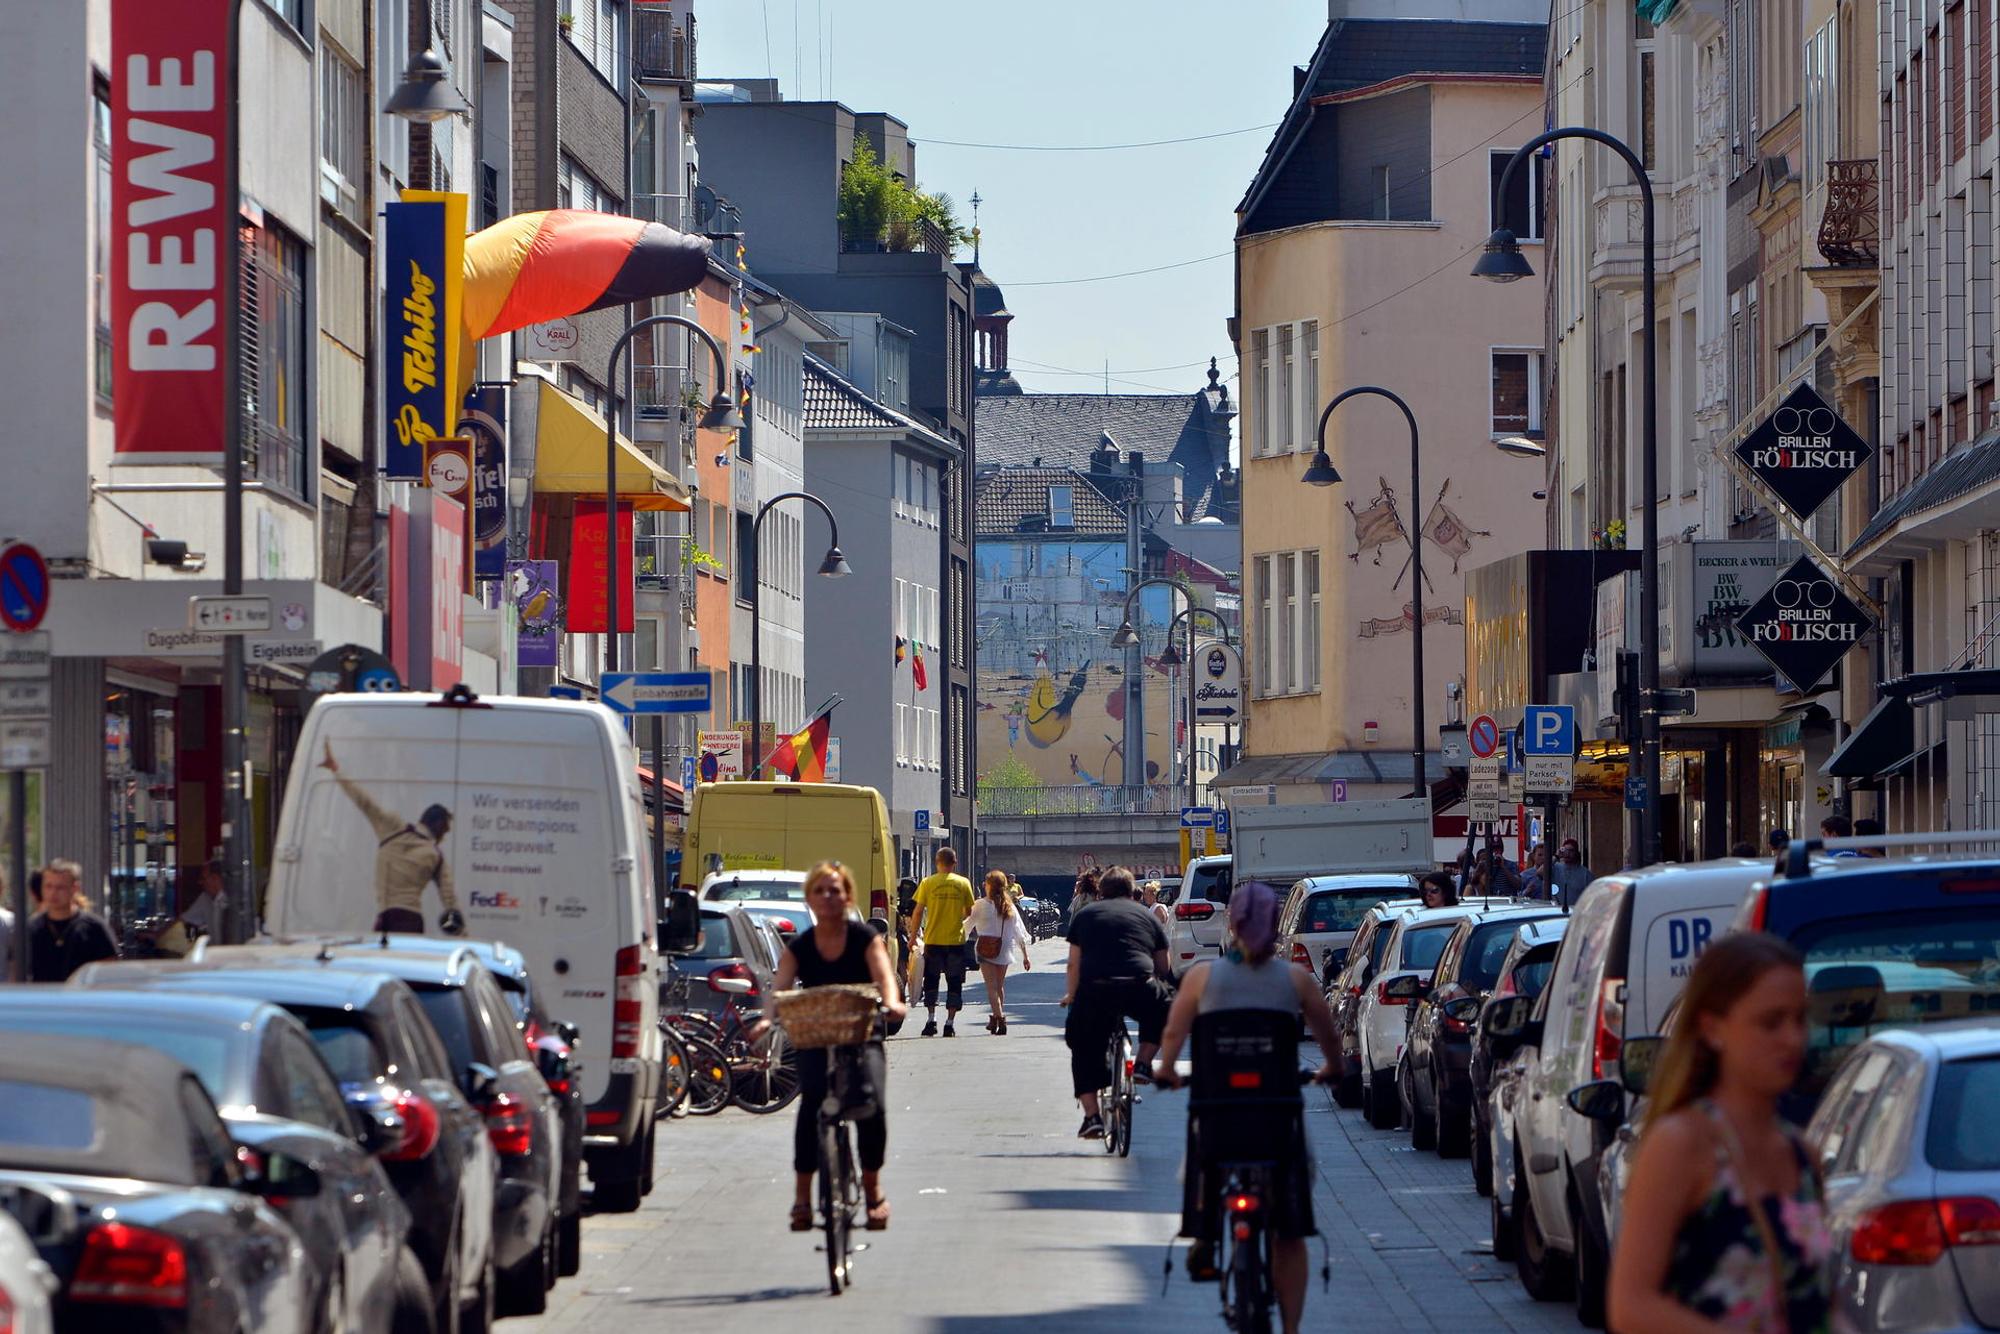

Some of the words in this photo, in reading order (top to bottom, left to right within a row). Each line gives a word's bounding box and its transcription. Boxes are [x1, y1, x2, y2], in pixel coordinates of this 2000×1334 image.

[127, 50, 215, 371] REWE
[403, 258, 436, 394] Tchibo
[546, 329, 570, 340] KRALL
[1778, 436, 1832, 449] BRILLEN
[1698, 557, 1739, 567] BECKER
[1740, 557, 1748, 567] &
[1717, 573, 1739, 585] BW
[1713, 584, 1743, 600] BW
[1778, 609, 1832, 621] BRILLEN
[252, 644, 318, 661] Eigelstein
[633, 687, 705, 698] Einbahnstraße
[1536, 711, 1563, 749] P
[472, 793, 499, 808] Wir
[503, 797, 580, 812] versenden
[471, 814, 492, 830] für
[496, 815, 580, 834] Champions.
[1217, 813, 1225, 831] P
[471, 835, 558, 856] Europaweit.
[470, 891, 521, 908] FedEx
